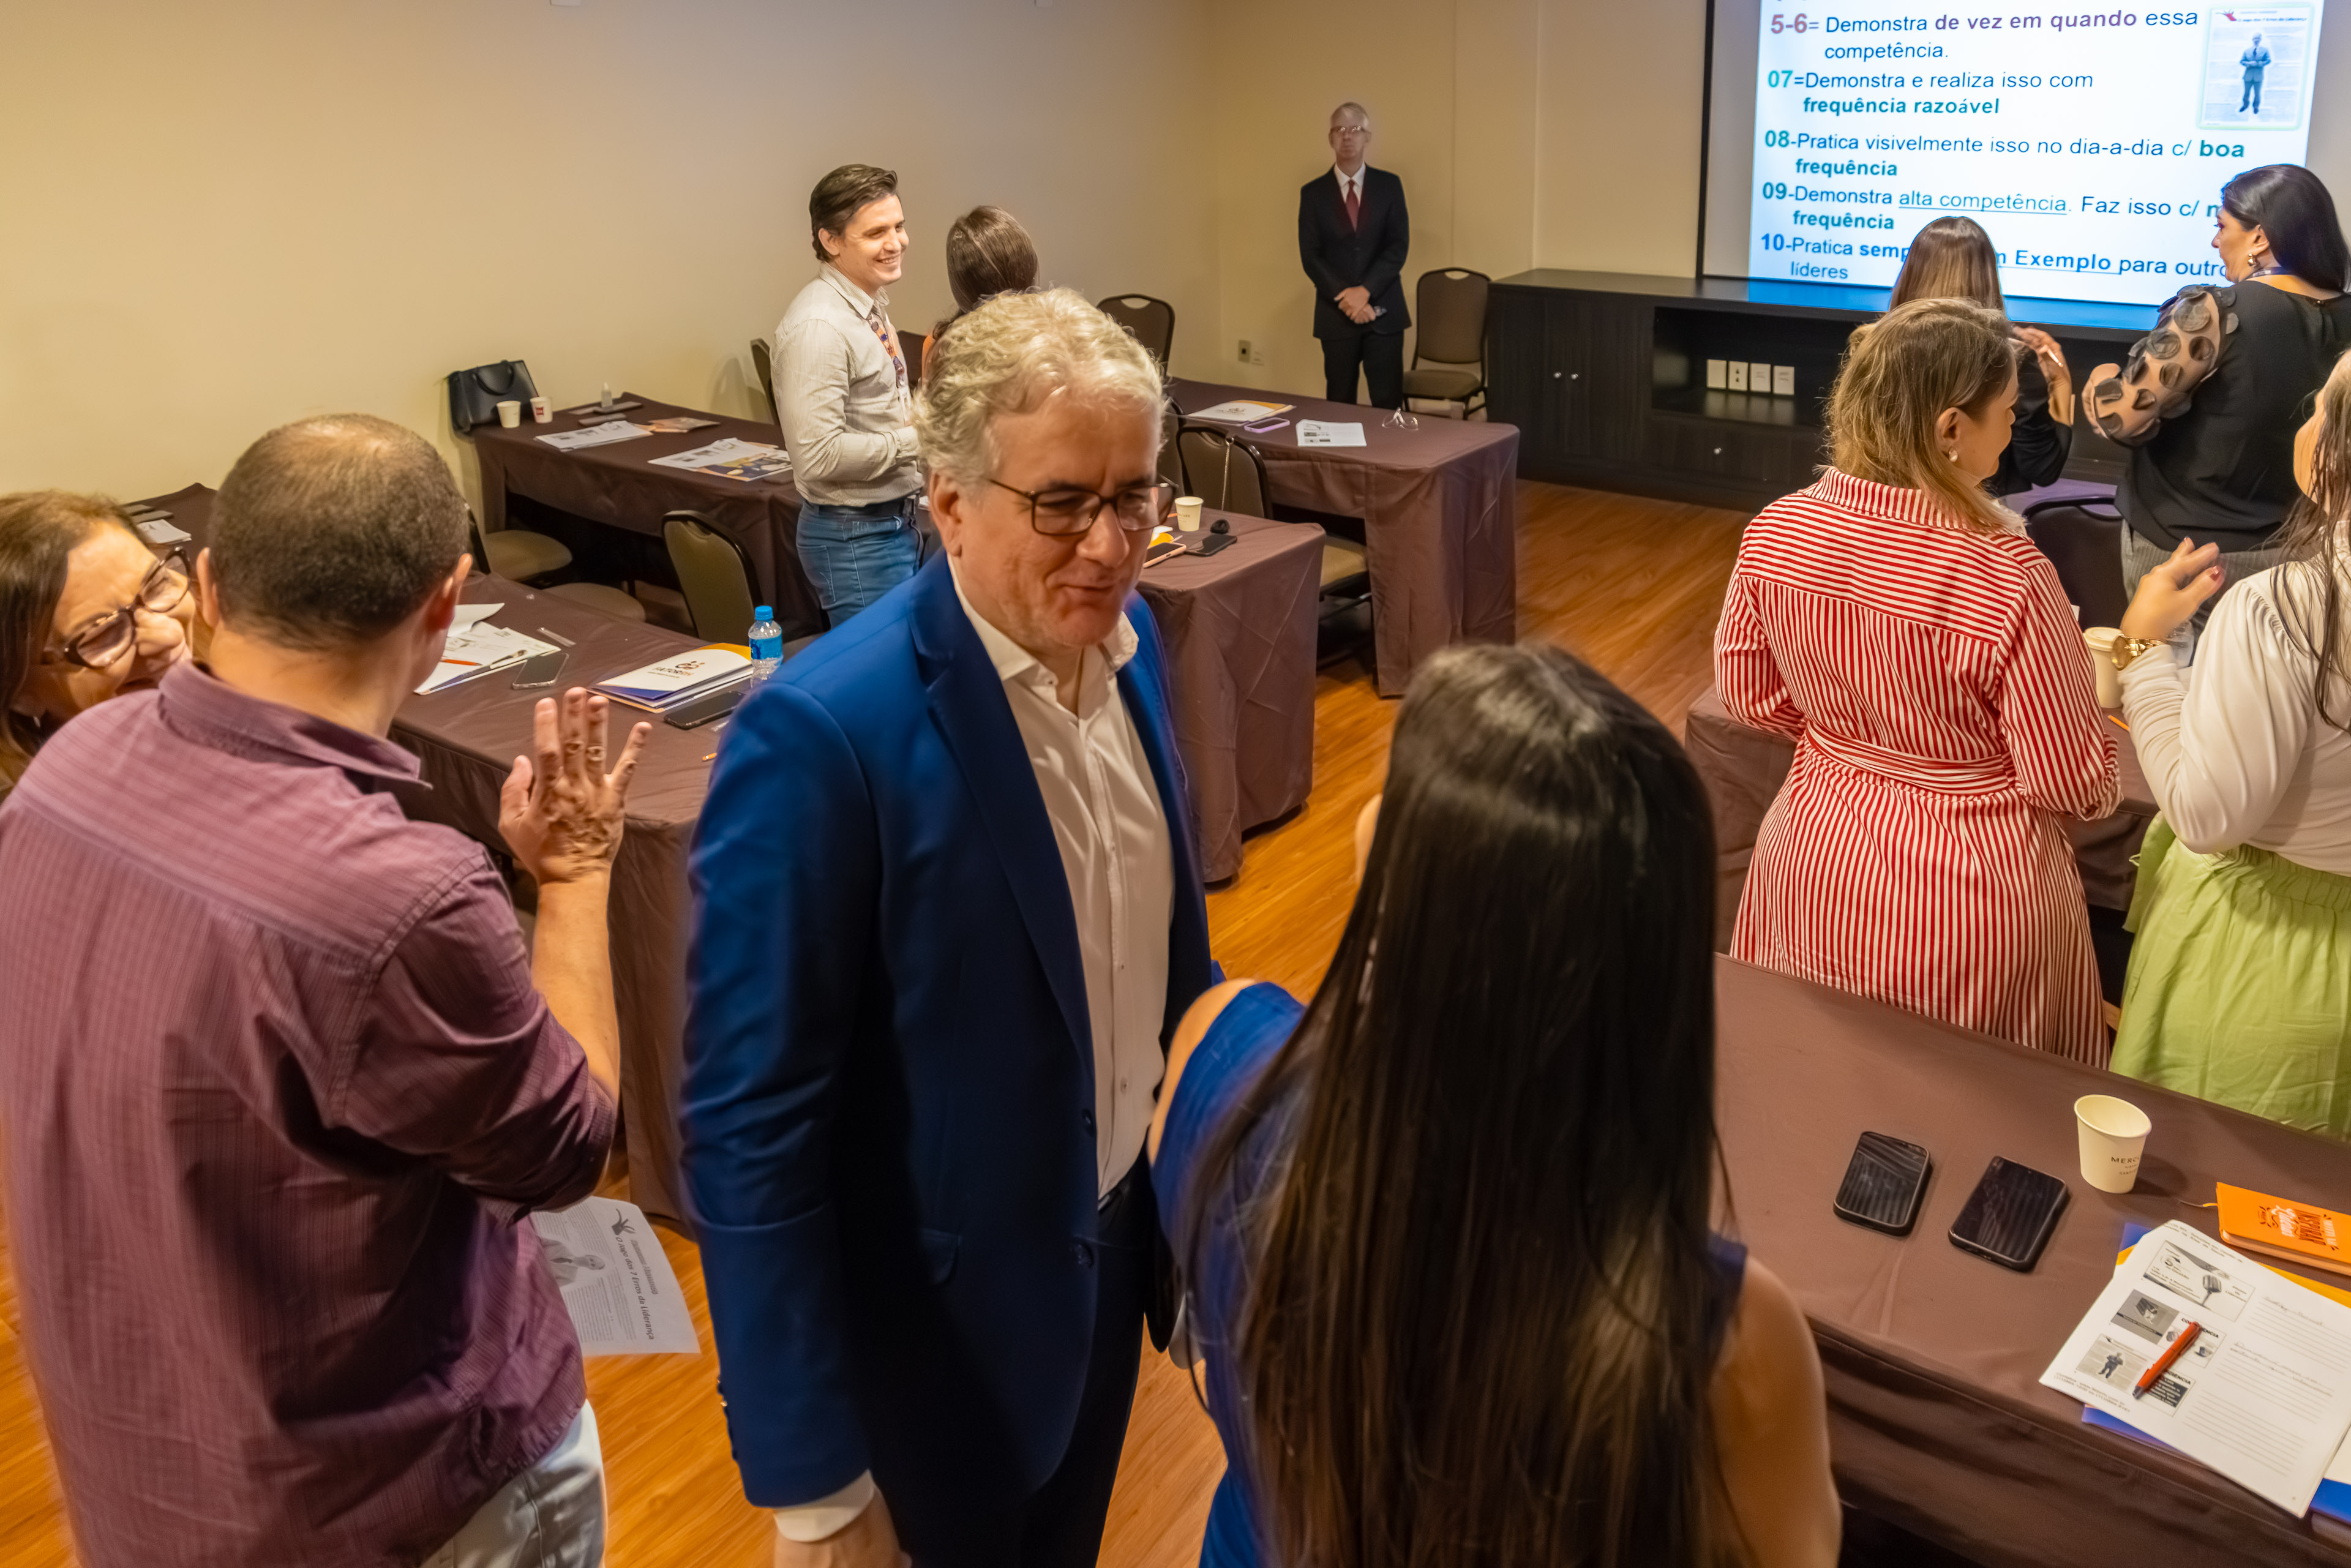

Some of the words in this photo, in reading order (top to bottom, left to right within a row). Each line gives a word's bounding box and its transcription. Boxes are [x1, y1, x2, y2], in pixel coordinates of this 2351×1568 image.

[1826, 16, 1927, 33] Demonstra
[1935, 14, 1960, 31] de
[1967, 17, 2003, 29] vez
[2009, 16, 2042, 29] em
[2050, 9, 2137, 32] quando
[2145, 12, 2198, 26] essa
[1824, 42, 1948, 62] competência.
[1912, 76, 1923, 88] e
[1930, 72, 1994, 88] realiza
[2002, 72, 2042, 88] isso
[2049, 75, 2093, 88] com
[1802, 97, 1907, 117] frequência
[1914, 97, 2000, 114] razoável
[1865, 134, 1983, 152] visivelmente
[1990, 136, 2030, 153] isso
[2038, 141, 2062, 154] no
[2069, 138, 2163, 156] dia-a-dia
[2172, 140, 2192, 156] c/
[2199, 140, 2244, 158] boa
[1795, 158, 1897, 179] frequência
[1899, 190, 1932, 206] alta
[1940, 193, 2072, 213] competência.
[2082, 196, 2120, 214] Faz
[2128, 198, 2172, 216] isso
[2179, 200, 2200, 217] c/
[1792, 209, 1894, 231] frequência
[1859, 244, 1910, 262] semp
[2015, 249, 2112, 272] Exemplo
[2117, 259, 2167, 276] para
[2175, 260, 2226, 276] outro
[1790, 261, 1848, 281] líderes
[625, 1258, 634, 1270] dos
[632, 1277, 642, 1294] Erros
[638, 1296, 646, 1304] da
[640, 1306, 654, 1340] Liderança
